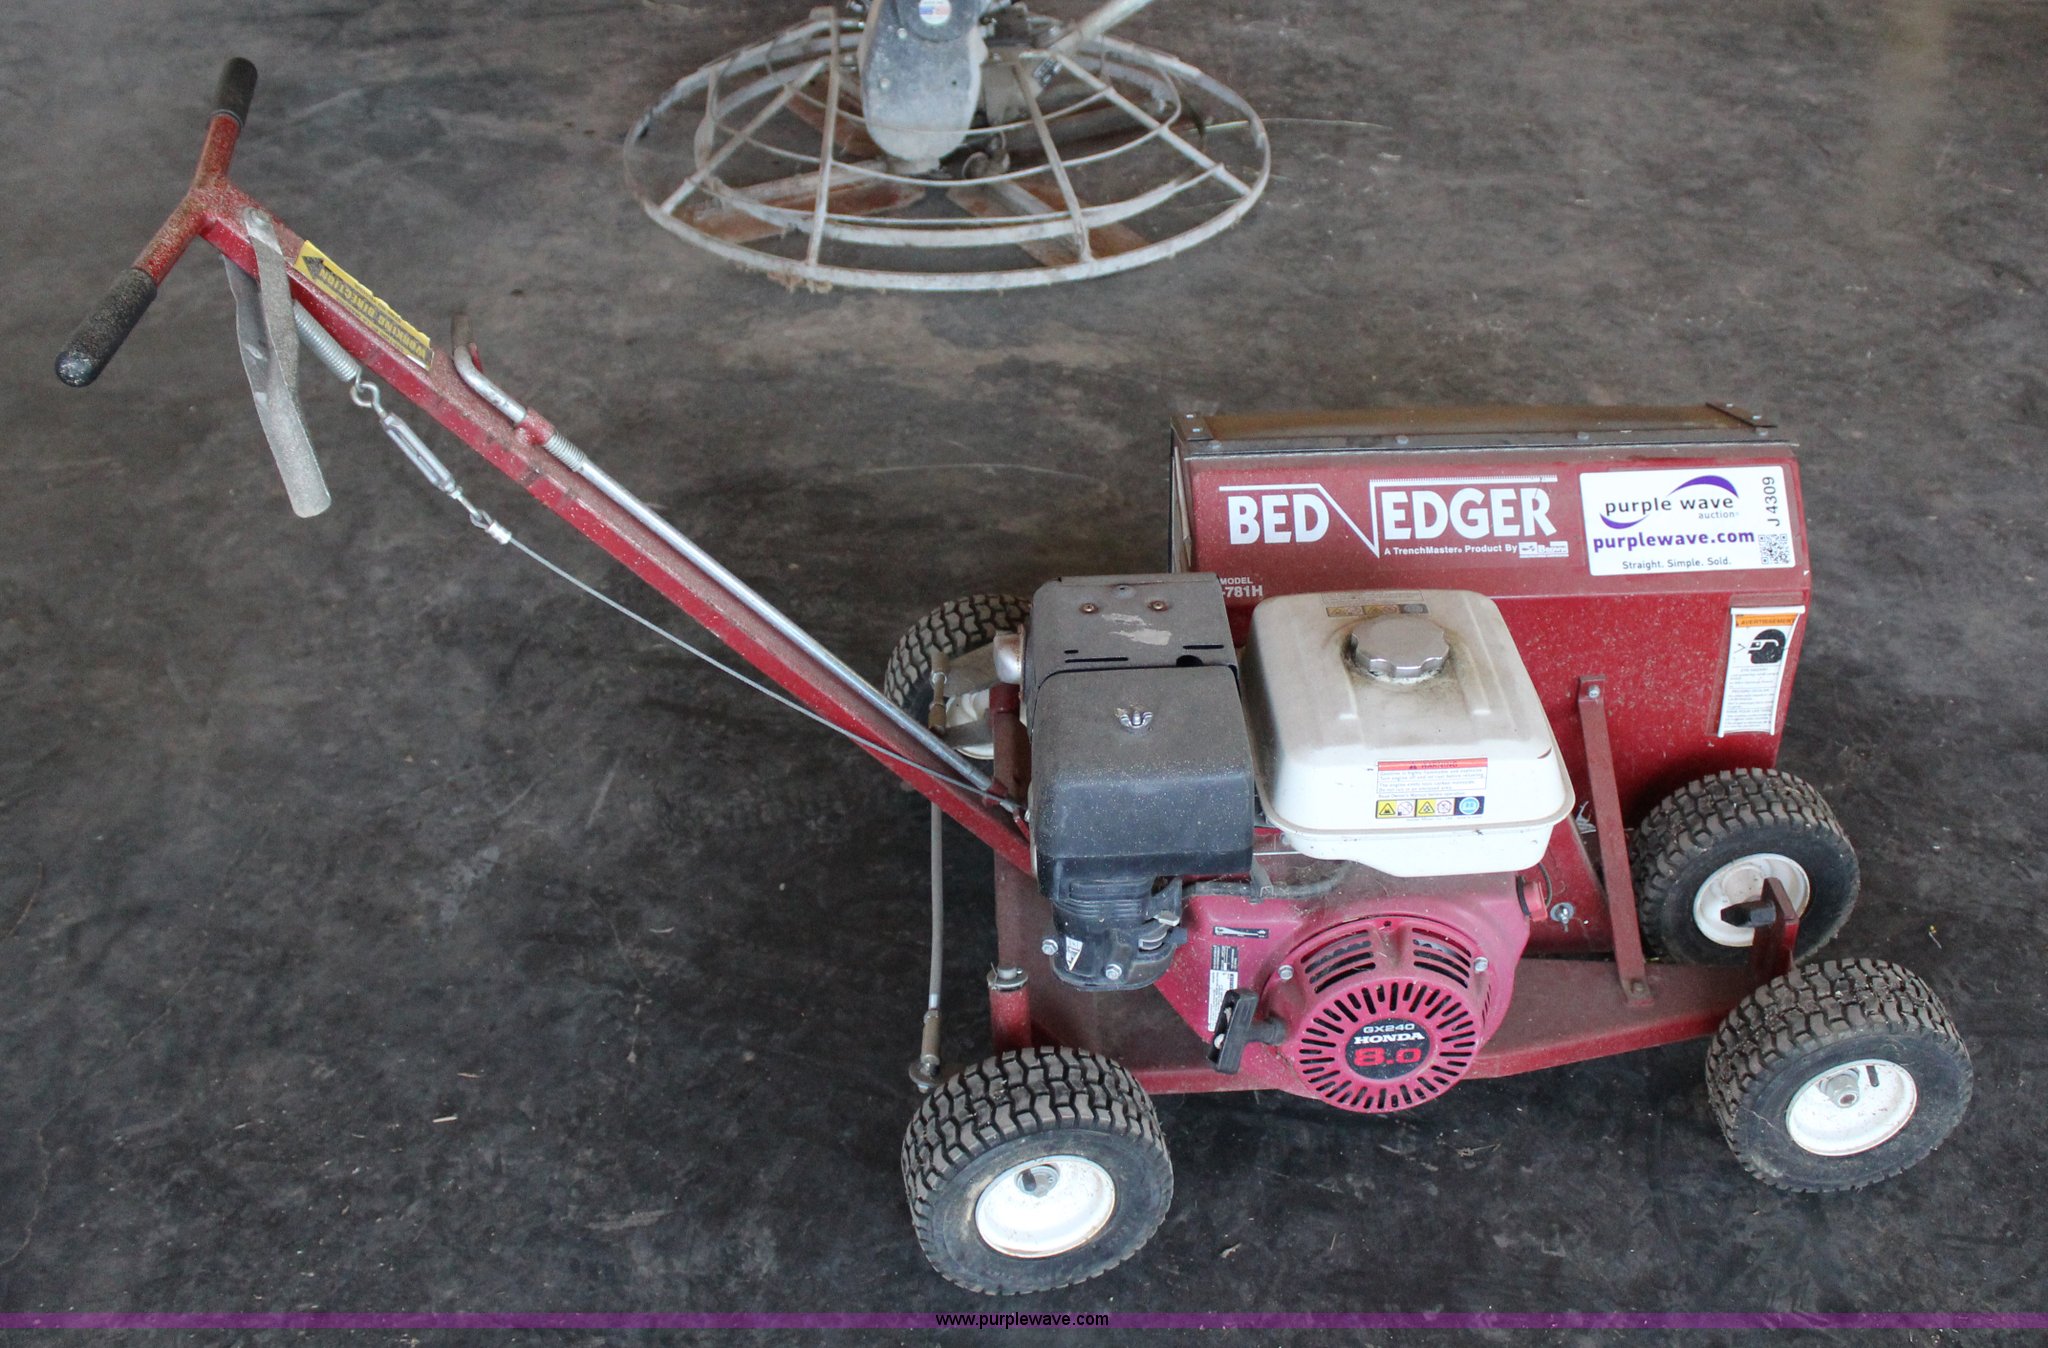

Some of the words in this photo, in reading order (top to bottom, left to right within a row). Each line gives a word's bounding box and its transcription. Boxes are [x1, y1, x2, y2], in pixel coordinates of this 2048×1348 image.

[1762, 476, 1778, 515] 4309
[1605, 497, 1672, 516] purple
[1680, 497, 1734, 510] wave
[1227, 493, 1330, 545] BED
[1381, 487, 1557, 539] EDGER
[1465, 545, 1502, 553] Product
[1505, 544, 1518, 554] By
[1593, 531, 1755, 552] purplewave.com
[1622, 560, 1664, 571] Straight.
[1667, 558, 1704, 568] Simple.
[1707, 556, 1731, 566] Sold.
[1220, 576, 1253, 585] MODEL
[1363, 1023, 1416, 1034] GX240
[1353, 1032, 1425, 1045] HONDA
[1353, 1047, 1422, 1067] 8.0
